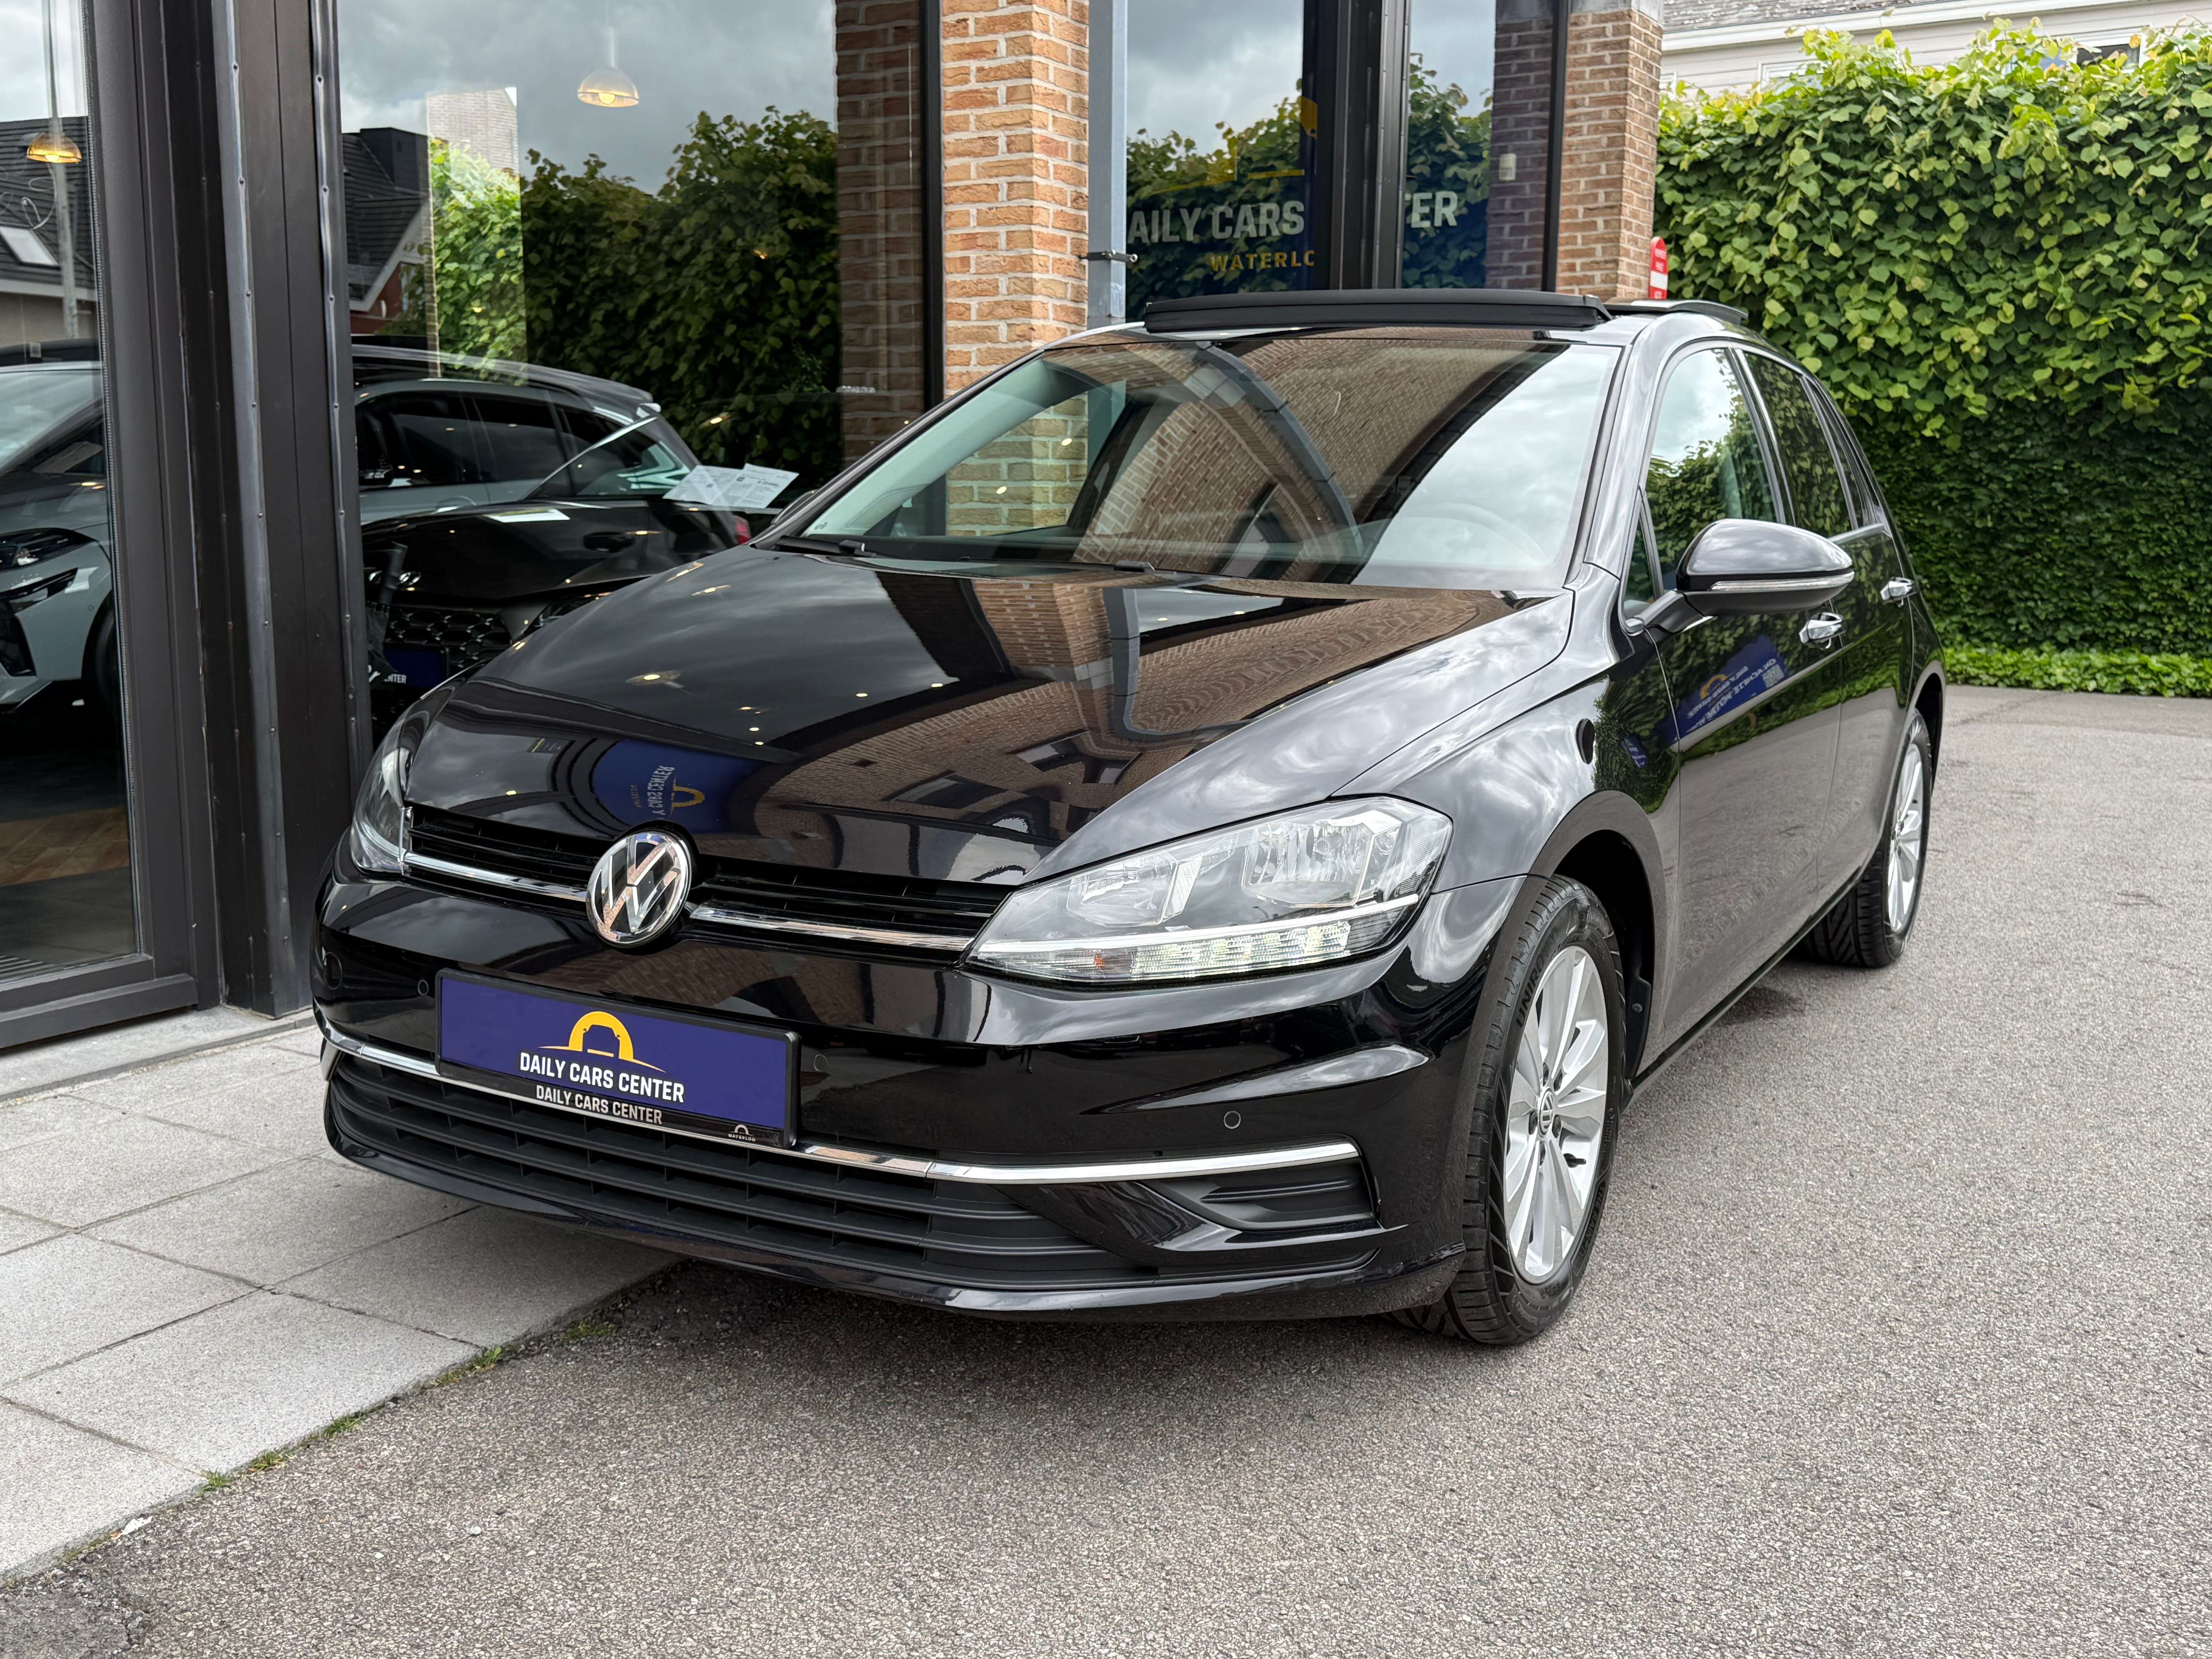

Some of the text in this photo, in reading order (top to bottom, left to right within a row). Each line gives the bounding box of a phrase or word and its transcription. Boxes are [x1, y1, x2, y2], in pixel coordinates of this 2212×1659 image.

[1127, 208, 1201, 244] AILY
[1212, 201, 1305, 239] CARS
[1210, 251, 1315, 271] WATERLO
[383, 673, 407, 684] NTER
[520, 1052, 684, 1103] DAILY CARS CENTER
[536, 1085, 663, 1125] DAILY CARS CENTER
